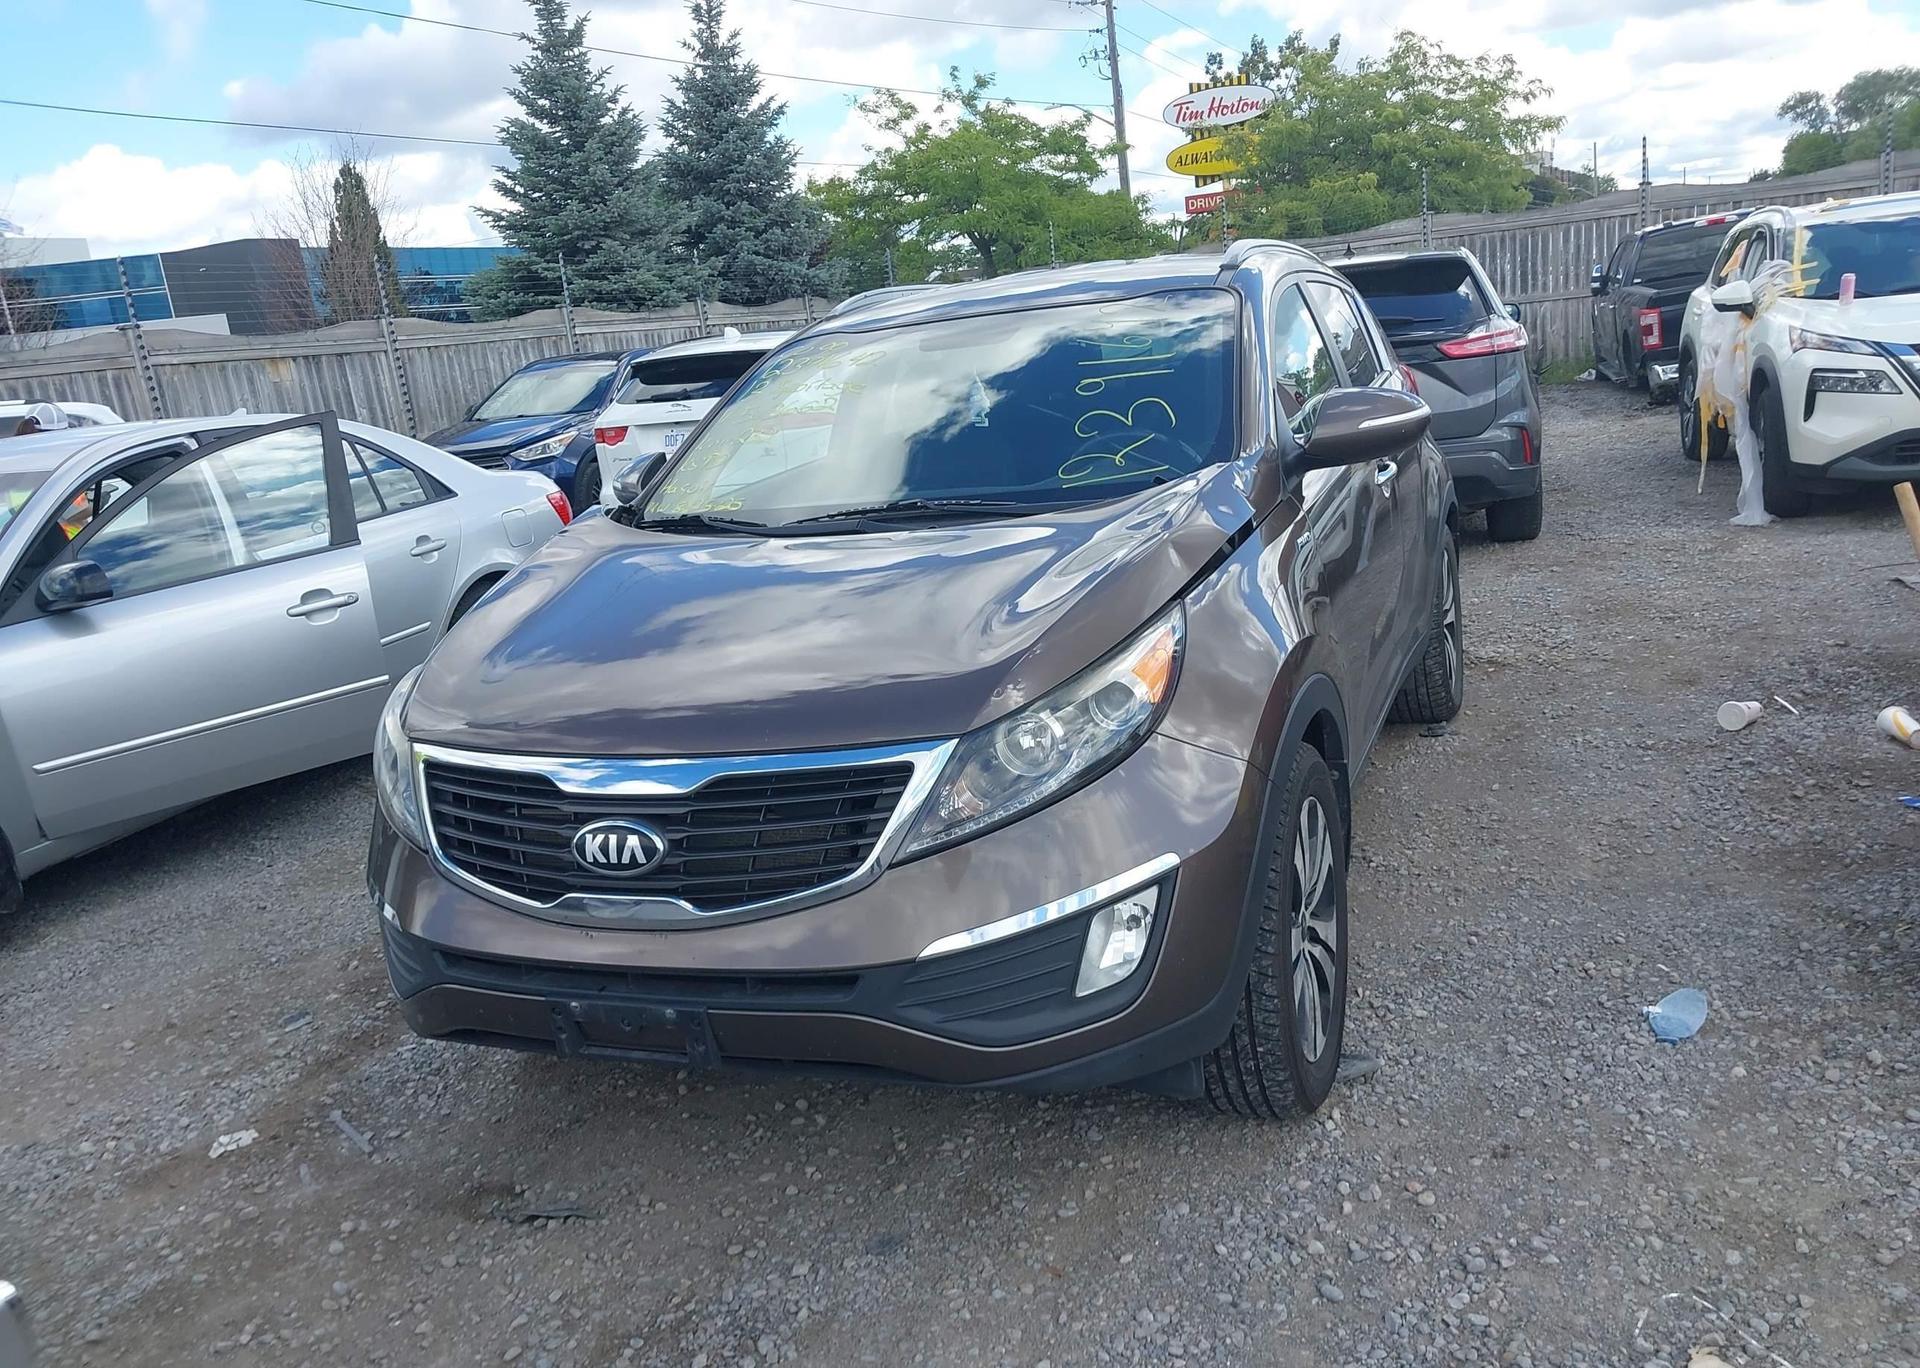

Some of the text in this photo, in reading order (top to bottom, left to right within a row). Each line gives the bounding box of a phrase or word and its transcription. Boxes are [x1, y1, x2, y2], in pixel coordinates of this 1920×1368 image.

[1172, 95, 1265, 124] Tim Horton
[585, 833, 647, 864] KIA
